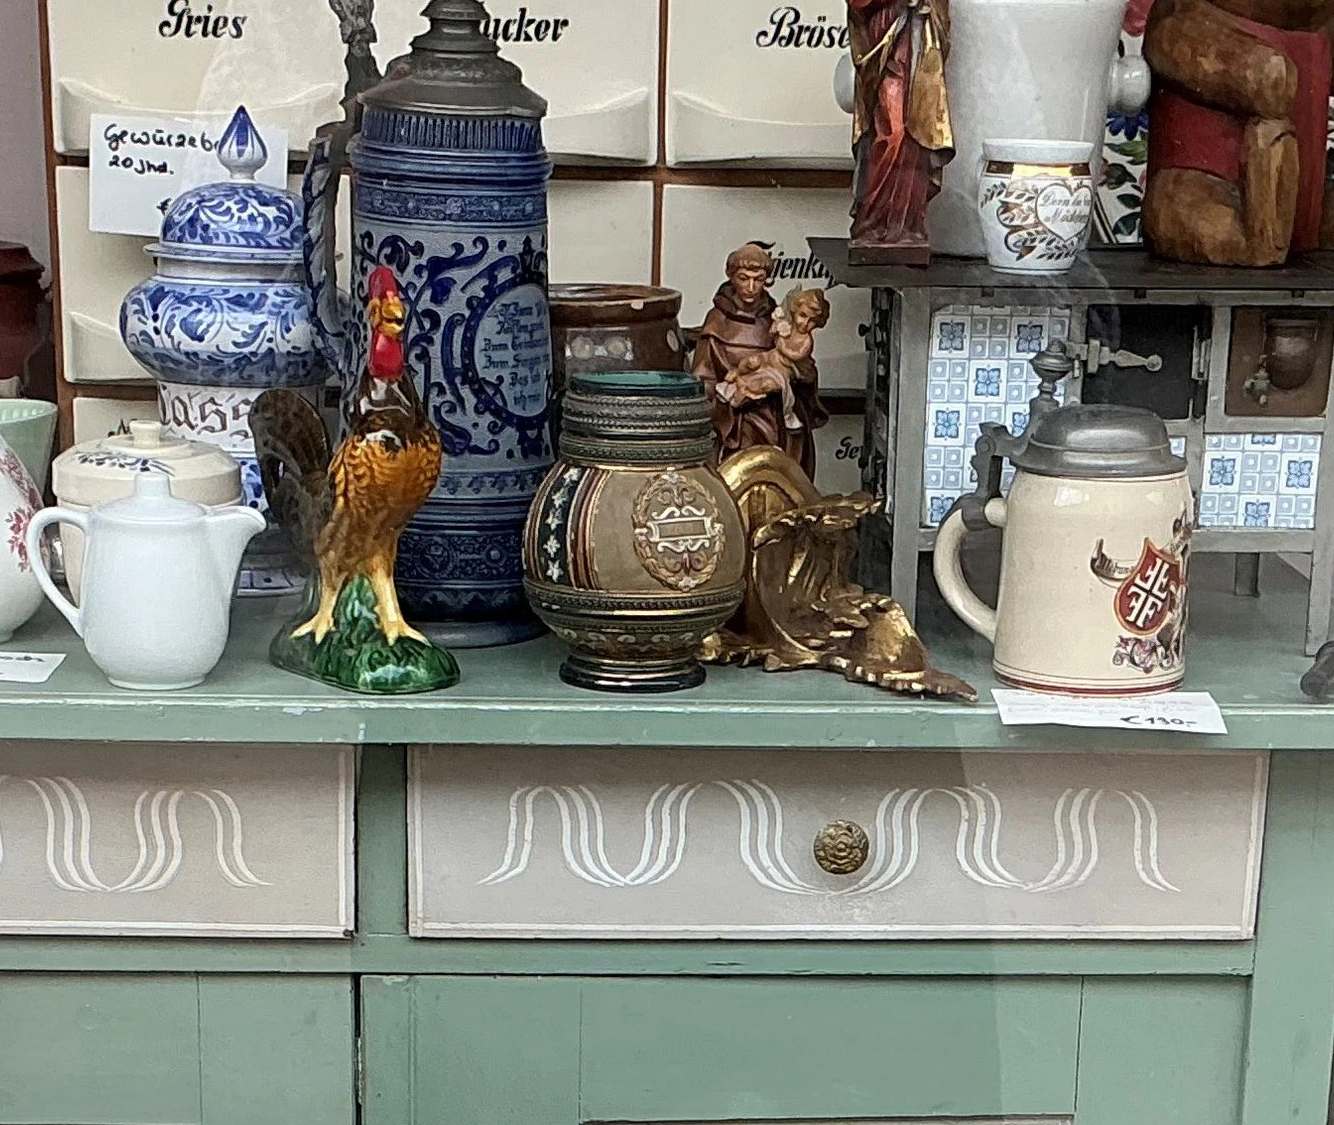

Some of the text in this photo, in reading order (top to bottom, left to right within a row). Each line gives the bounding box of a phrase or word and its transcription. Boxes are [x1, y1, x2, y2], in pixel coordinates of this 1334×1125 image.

[158, 0, 248, 38] Gries
[482, 7, 570, 42] ucker
[755, 6, 850, 48] Bröse
[103, 123, 219, 150] Gewürzeb
